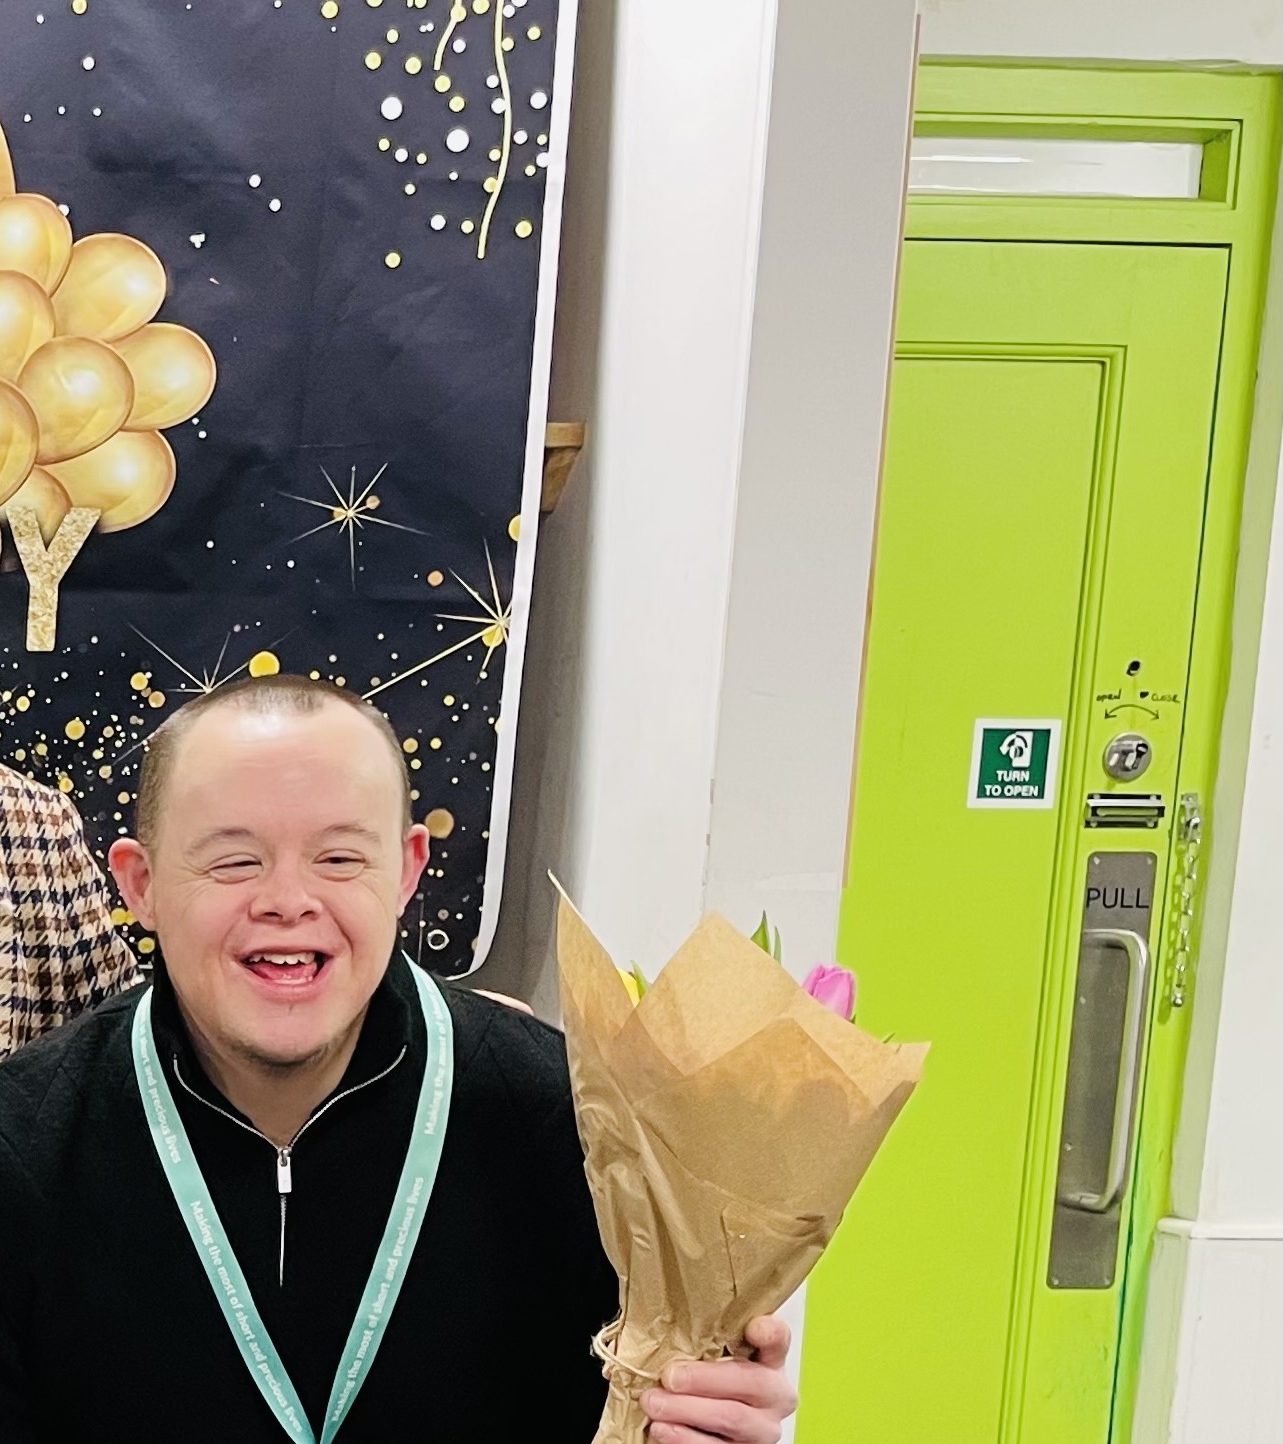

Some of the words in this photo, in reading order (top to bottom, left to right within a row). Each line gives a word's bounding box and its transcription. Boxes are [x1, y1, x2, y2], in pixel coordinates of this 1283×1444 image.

[996, 770, 1030, 782] TURN
[984, 784, 1002, 796] TO
[1003, 784, 1039, 796] OPEN
[1086, 888, 1149, 909] PULL
[148, 1087, 171, 1136] precious
[165, 1134, 181, 1164] lives
[406, 1177, 424, 1205] lives
[190, 1200, 214, 1246] Making
[393, 1206, 415, 1257] precious
[209, 1245, 222, 1266] the
[385, 1257, 399, 1281] and
[217, 1266, 236, 1296] most
[230, 1296, 244, 1309] of
[372, 1283, 391, 1314] short
[235, 1311, 256, 1341] short
[368, 1314, 379, 1328] of
[249, 1342, 267, 1362] and
[356, 1329, 374, 1360] most
[347, 1359, 362, 1378] the
[257, 1362, 288, 1408] precious
[285, 1406, 303, 1433] lives
